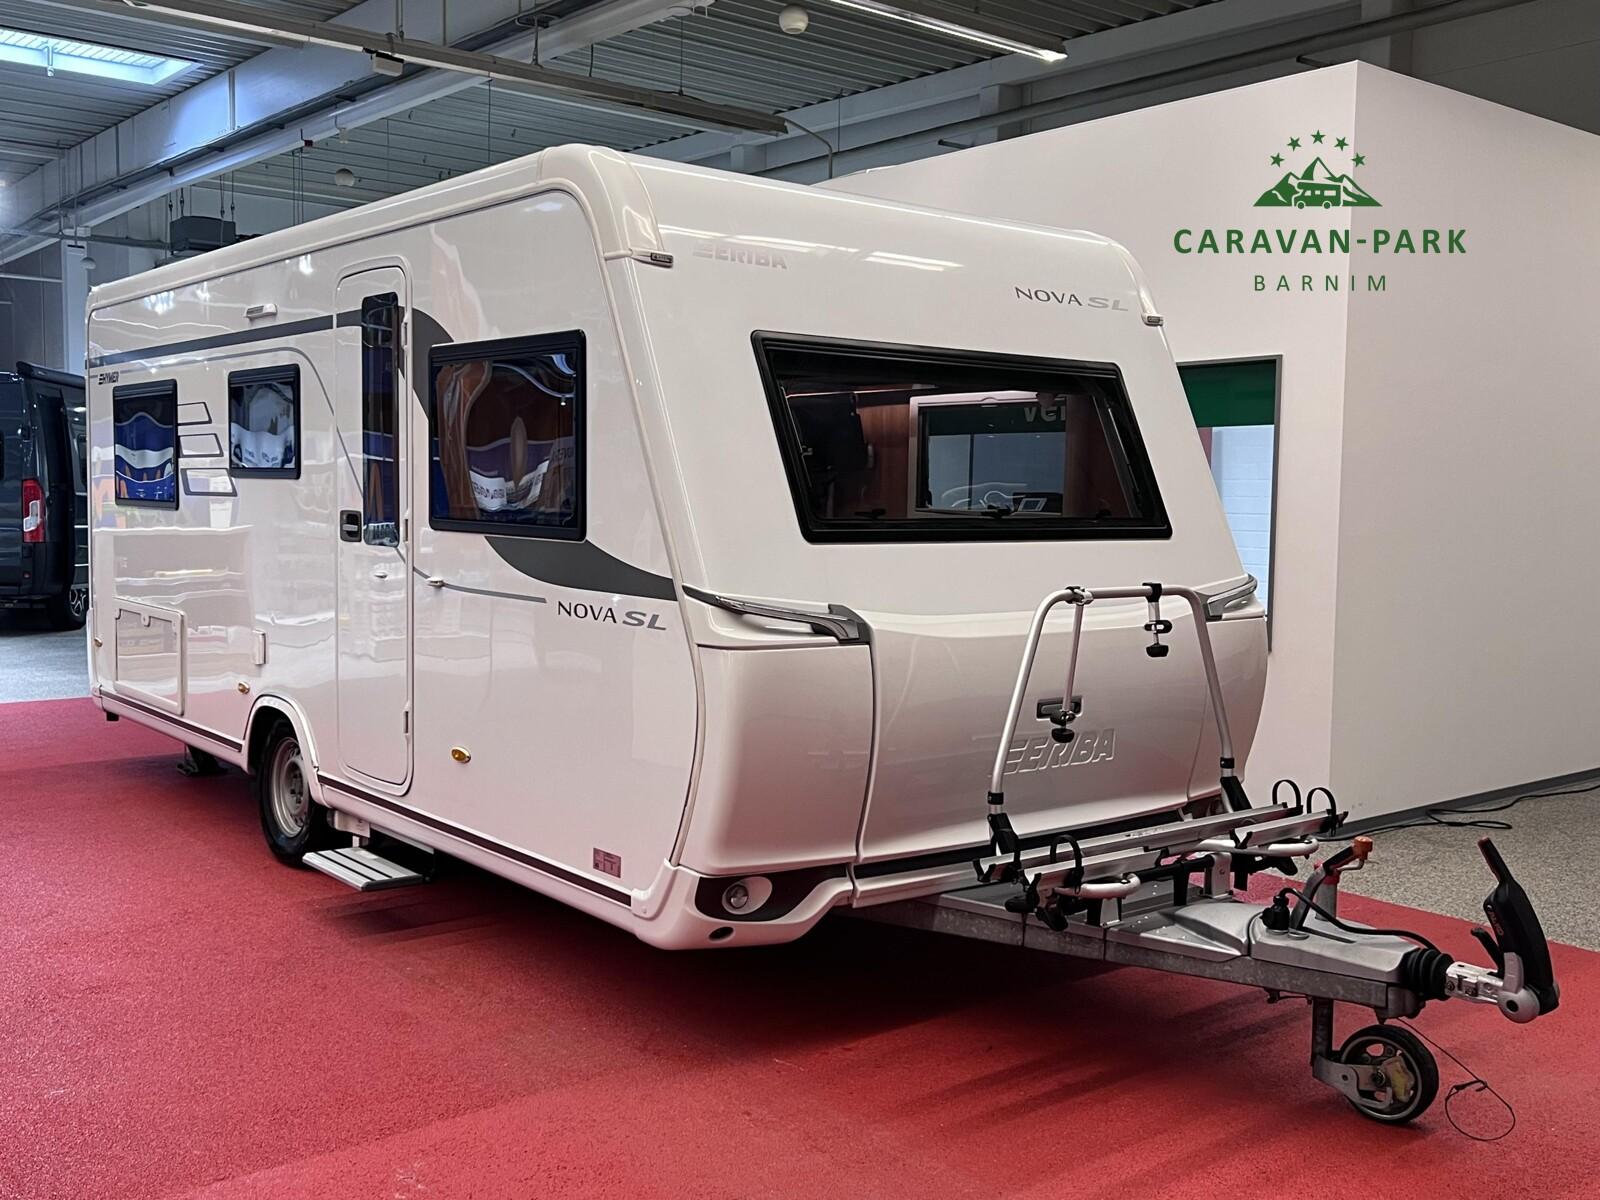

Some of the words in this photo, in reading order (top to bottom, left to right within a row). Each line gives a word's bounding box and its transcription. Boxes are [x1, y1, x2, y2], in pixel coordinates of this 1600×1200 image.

[1014, 286, 1083, 307] NOVA
[1087, 296, 1129, 312] SL
[557, 600, 617, 624] NOVA
[622, 610, 667, 631] SL
